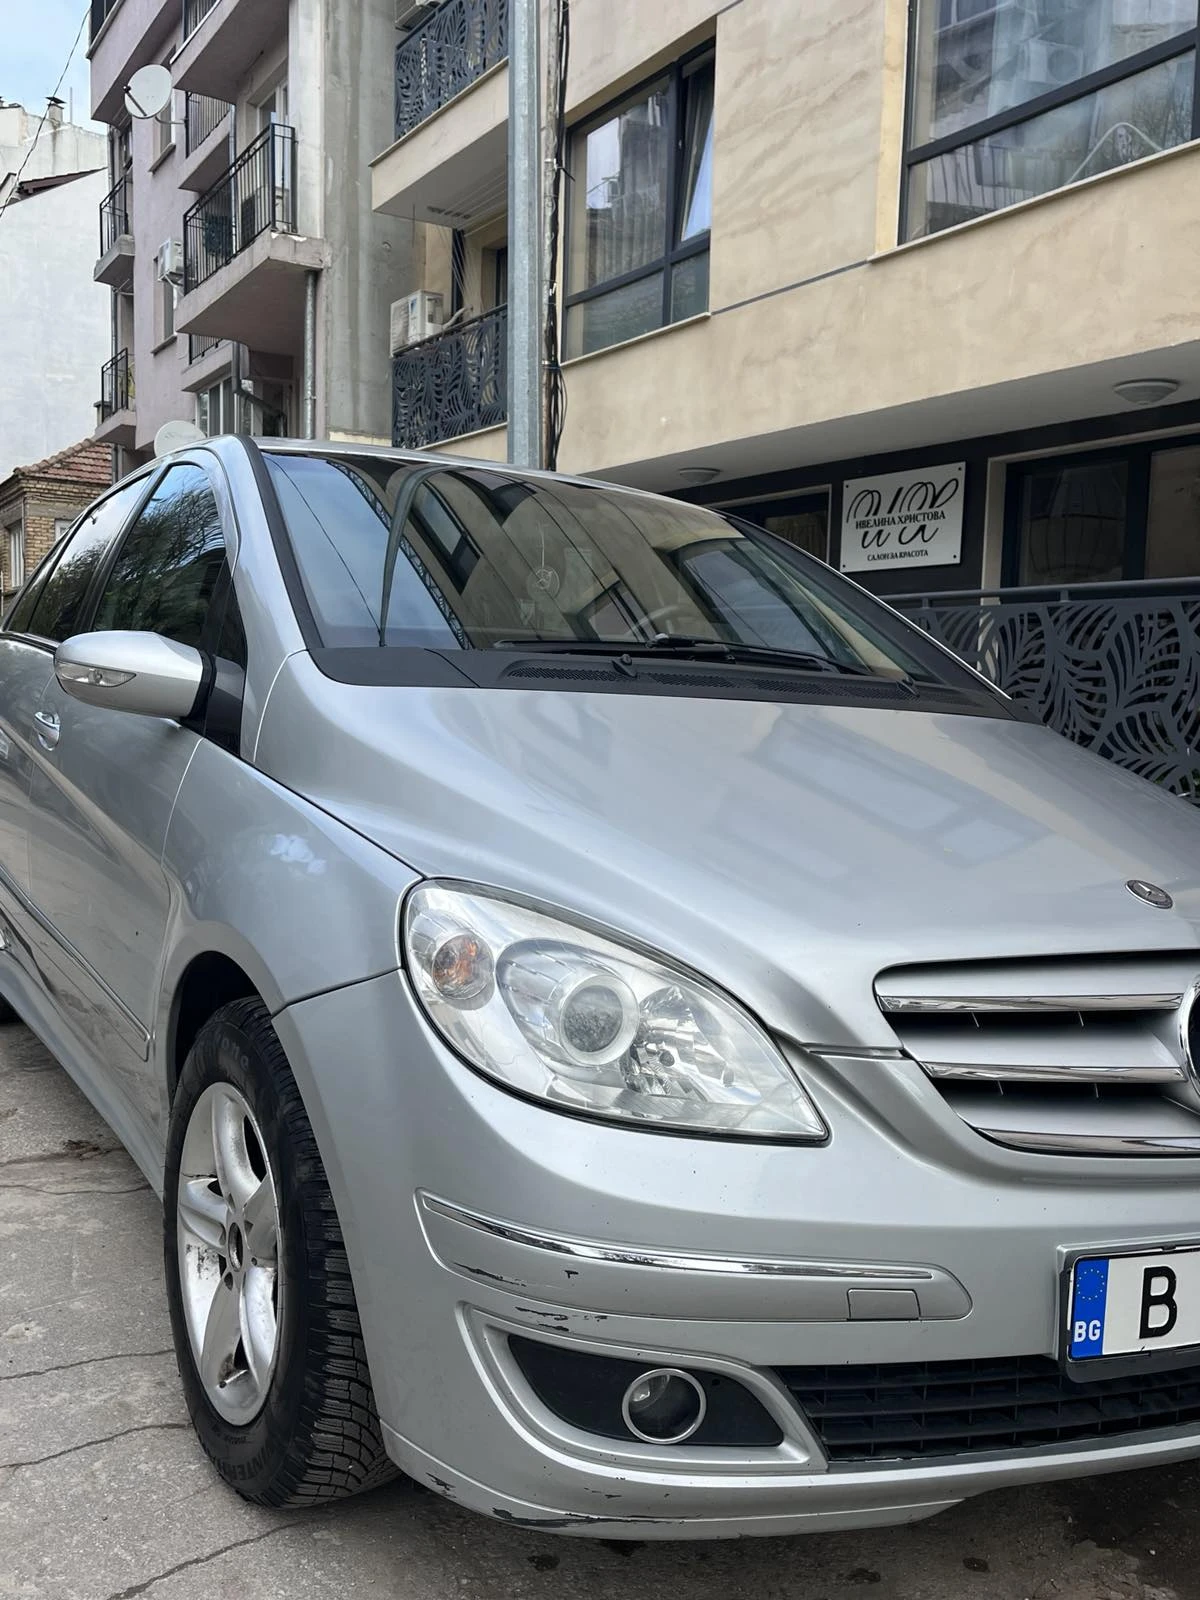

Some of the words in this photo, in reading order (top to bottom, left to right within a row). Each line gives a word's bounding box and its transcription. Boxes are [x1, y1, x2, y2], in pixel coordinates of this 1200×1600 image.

[855, 515, 896, 530] ИВЕЛИНА
[896, 510, 945, 524] ХРИСТОВА
[867, 552, 890, 562] САЛОН
[890, 551, 898, 560] ЗА
[899, 549, 929, 560] КРАСОТА
[1139, 1266, 1177, 1339] B
[1074, 1320, 1101, 1343] BG
